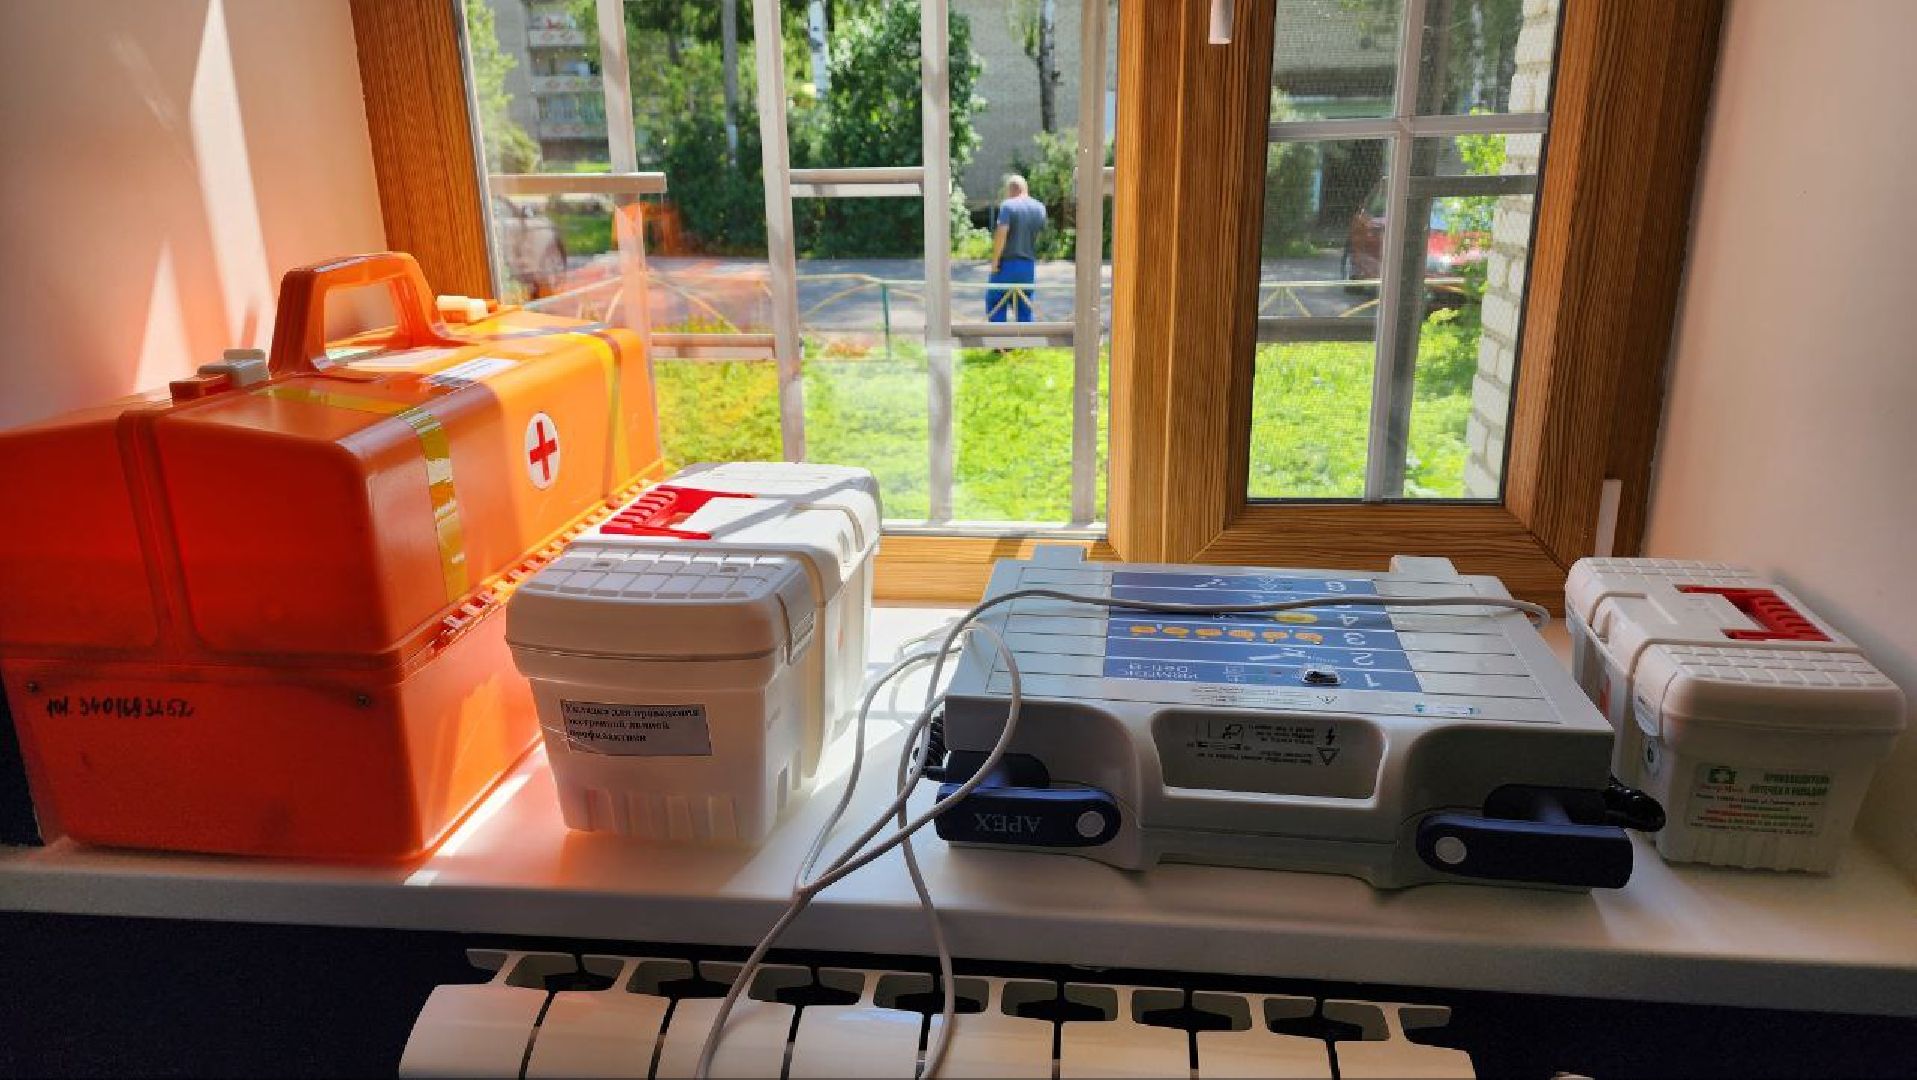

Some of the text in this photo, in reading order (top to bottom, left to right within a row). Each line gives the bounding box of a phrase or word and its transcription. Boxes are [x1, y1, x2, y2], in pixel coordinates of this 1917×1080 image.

[1336, 613, 1360, 626] 4
[1343, 631, 1366, 645] 3
[1350, 651, 1376, 666] 2
[1363, 672, 1382, 687] 1
[973, 812, 1042, 834] APEX
